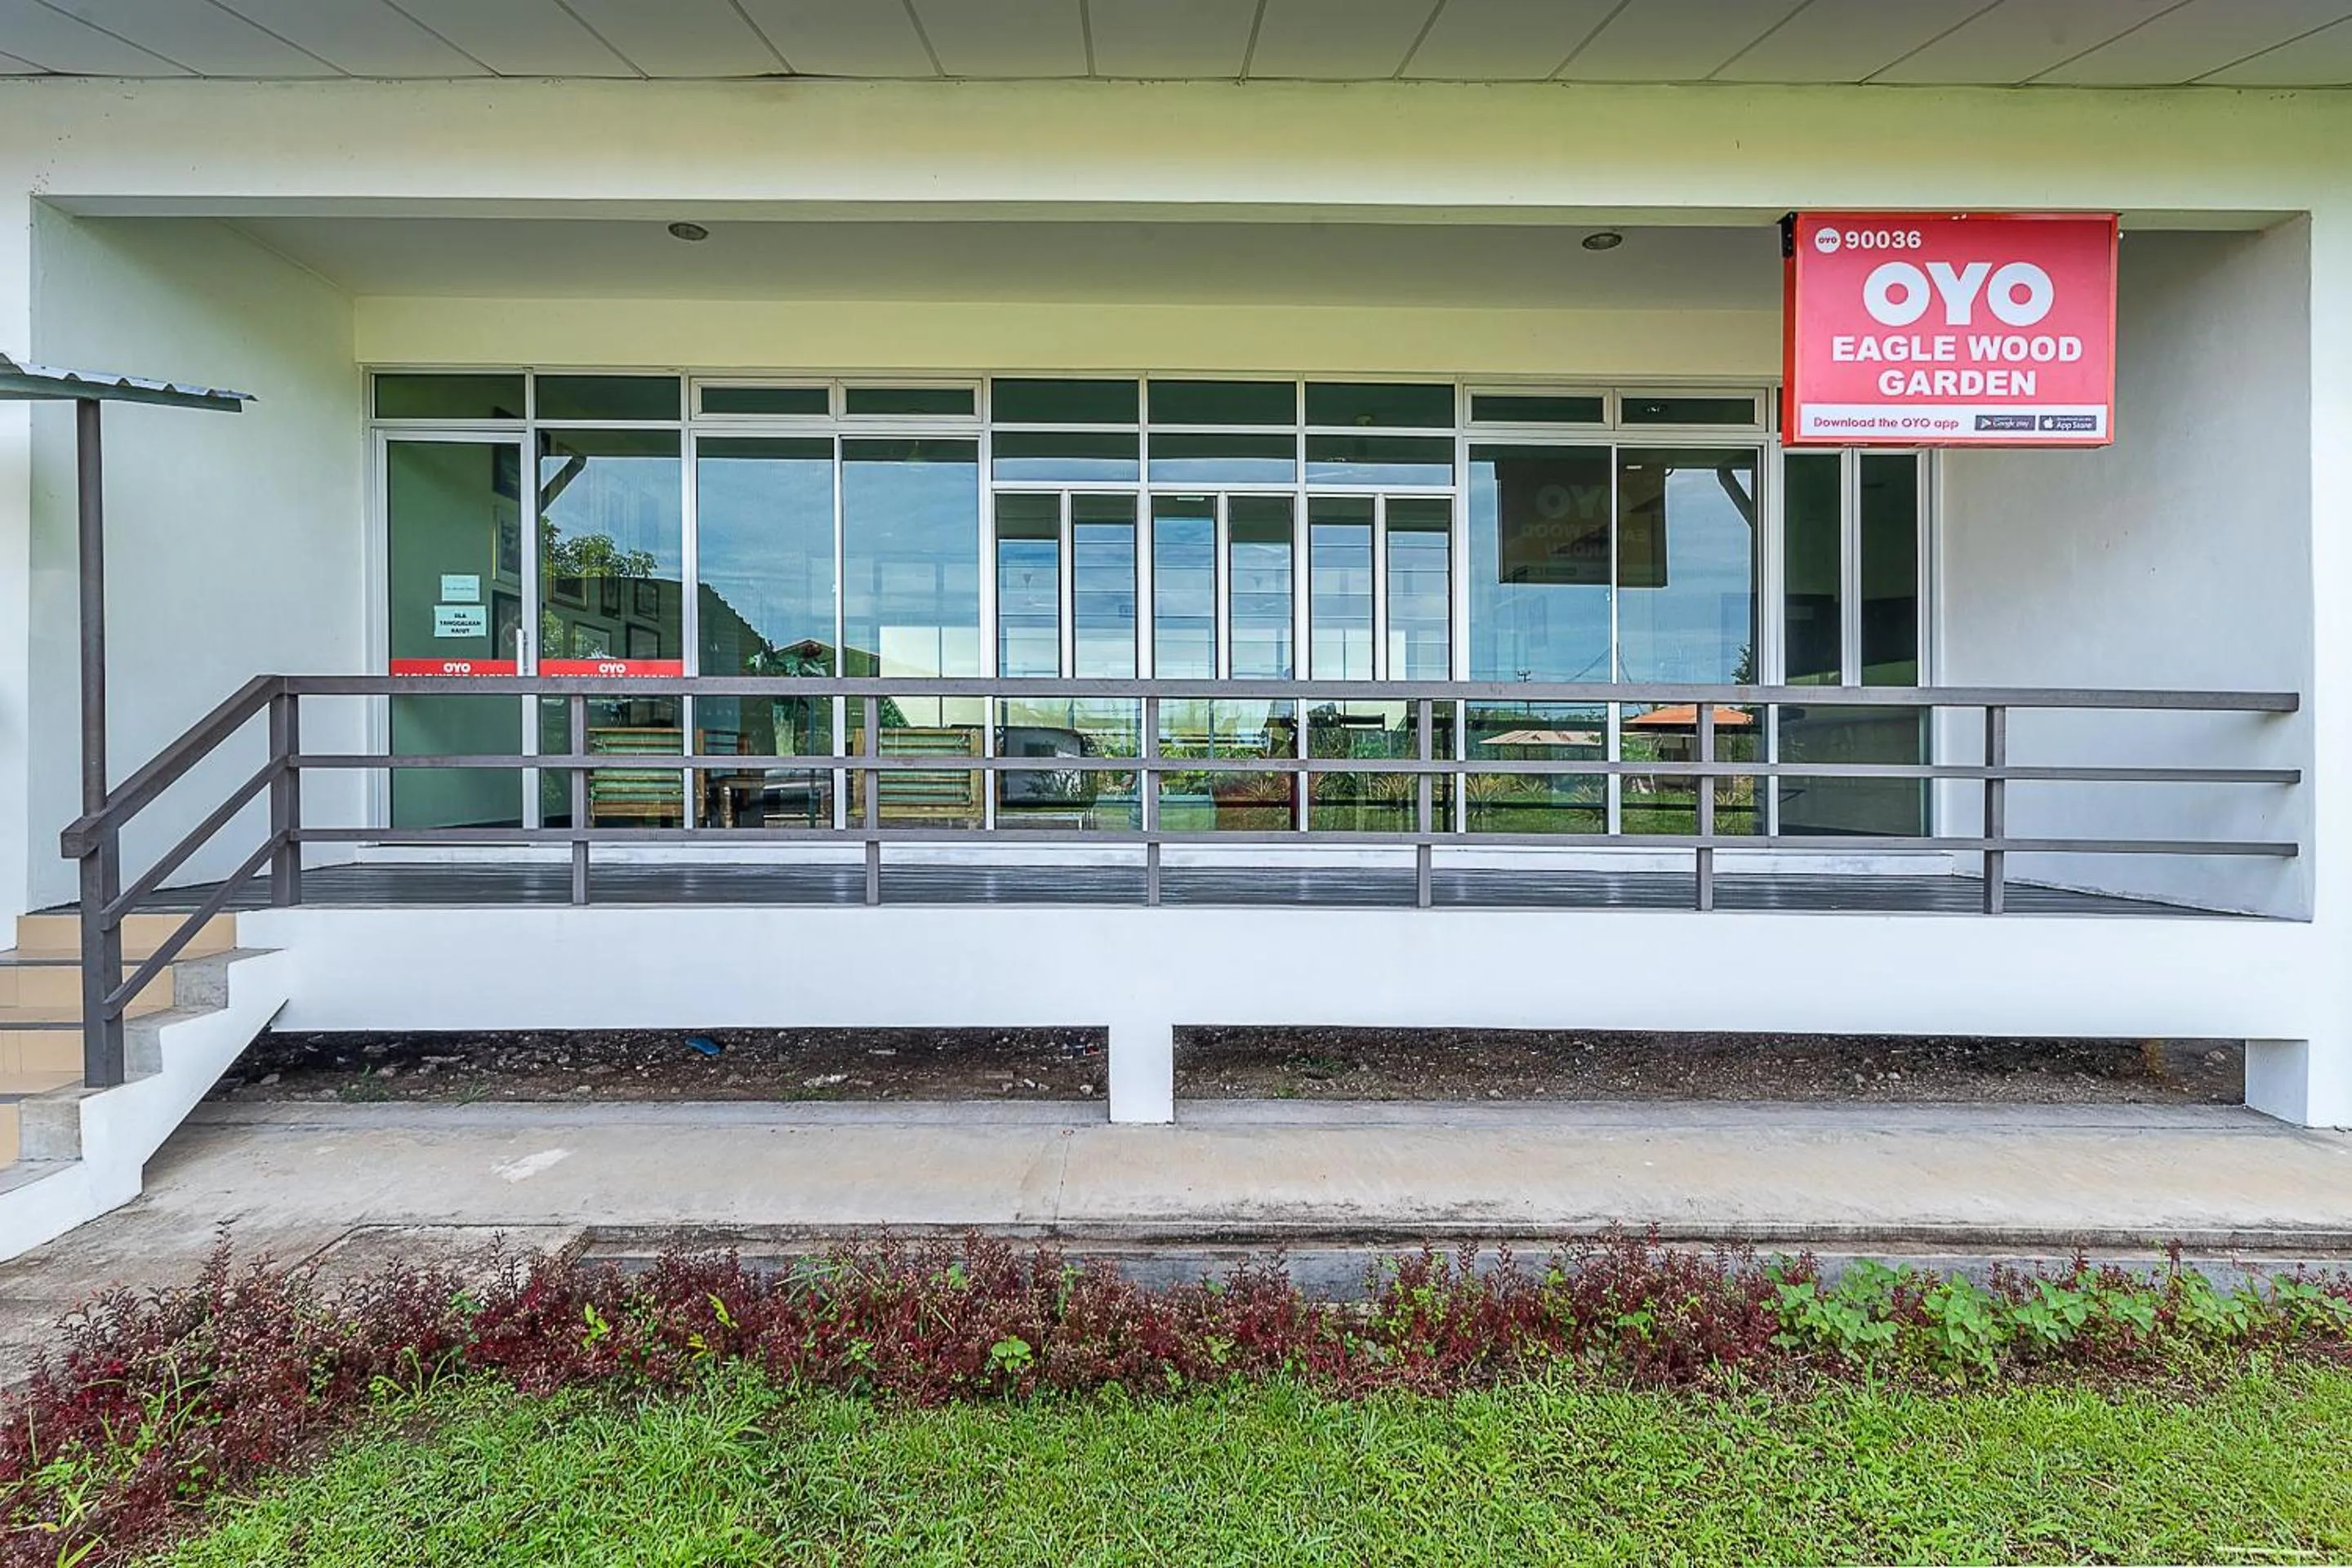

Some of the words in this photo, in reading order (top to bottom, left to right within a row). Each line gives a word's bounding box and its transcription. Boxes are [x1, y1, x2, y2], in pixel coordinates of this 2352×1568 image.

[1818, 235, 1838, 244] OYO
[1845, 230, 1922, 249] 90036
[1863, 261, 2054, 326] OYO
[1832, 335, 1956, 362] EAGLE
[1967, 335, 2082, 362] WOOD
[1878, 369, 2036, 396] GARDEN
[1813, 416, 1875, 427] Download
[1879, 417, 1898, 427] the
[1901, 417, 1931, 428] OYO
[1934, 420, 1959, 430] app
[2056, 422, 2071, 430] App
[2072, 421, 2092, 430] Store
[443, 662, 471, 674] OYO
[599, 662, 626, 674] OYO
